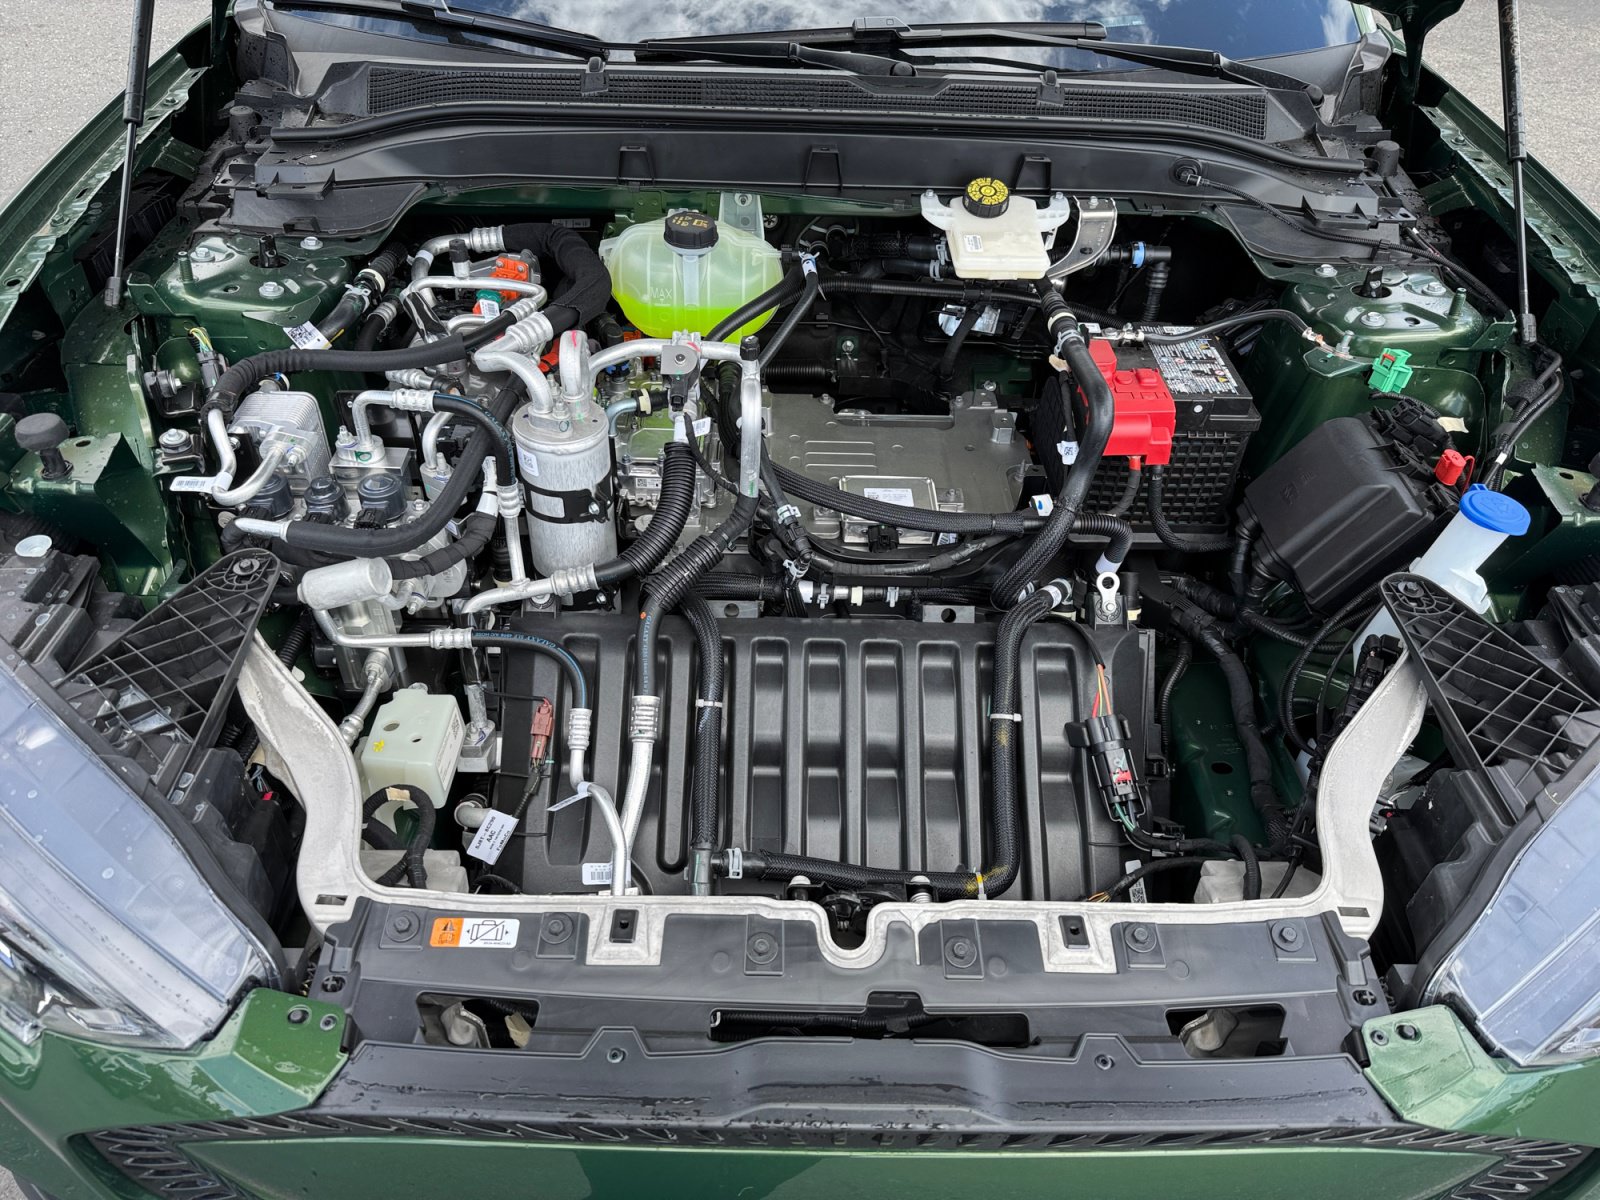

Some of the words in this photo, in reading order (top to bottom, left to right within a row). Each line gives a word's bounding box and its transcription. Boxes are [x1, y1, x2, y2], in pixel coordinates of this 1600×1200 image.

[650, 287, 672, 299] MAX
[643, 615, 651, 641] GALAXY
[527, 635, 556, 648] GALAXY
[486, 830, 496, 842] AAC
